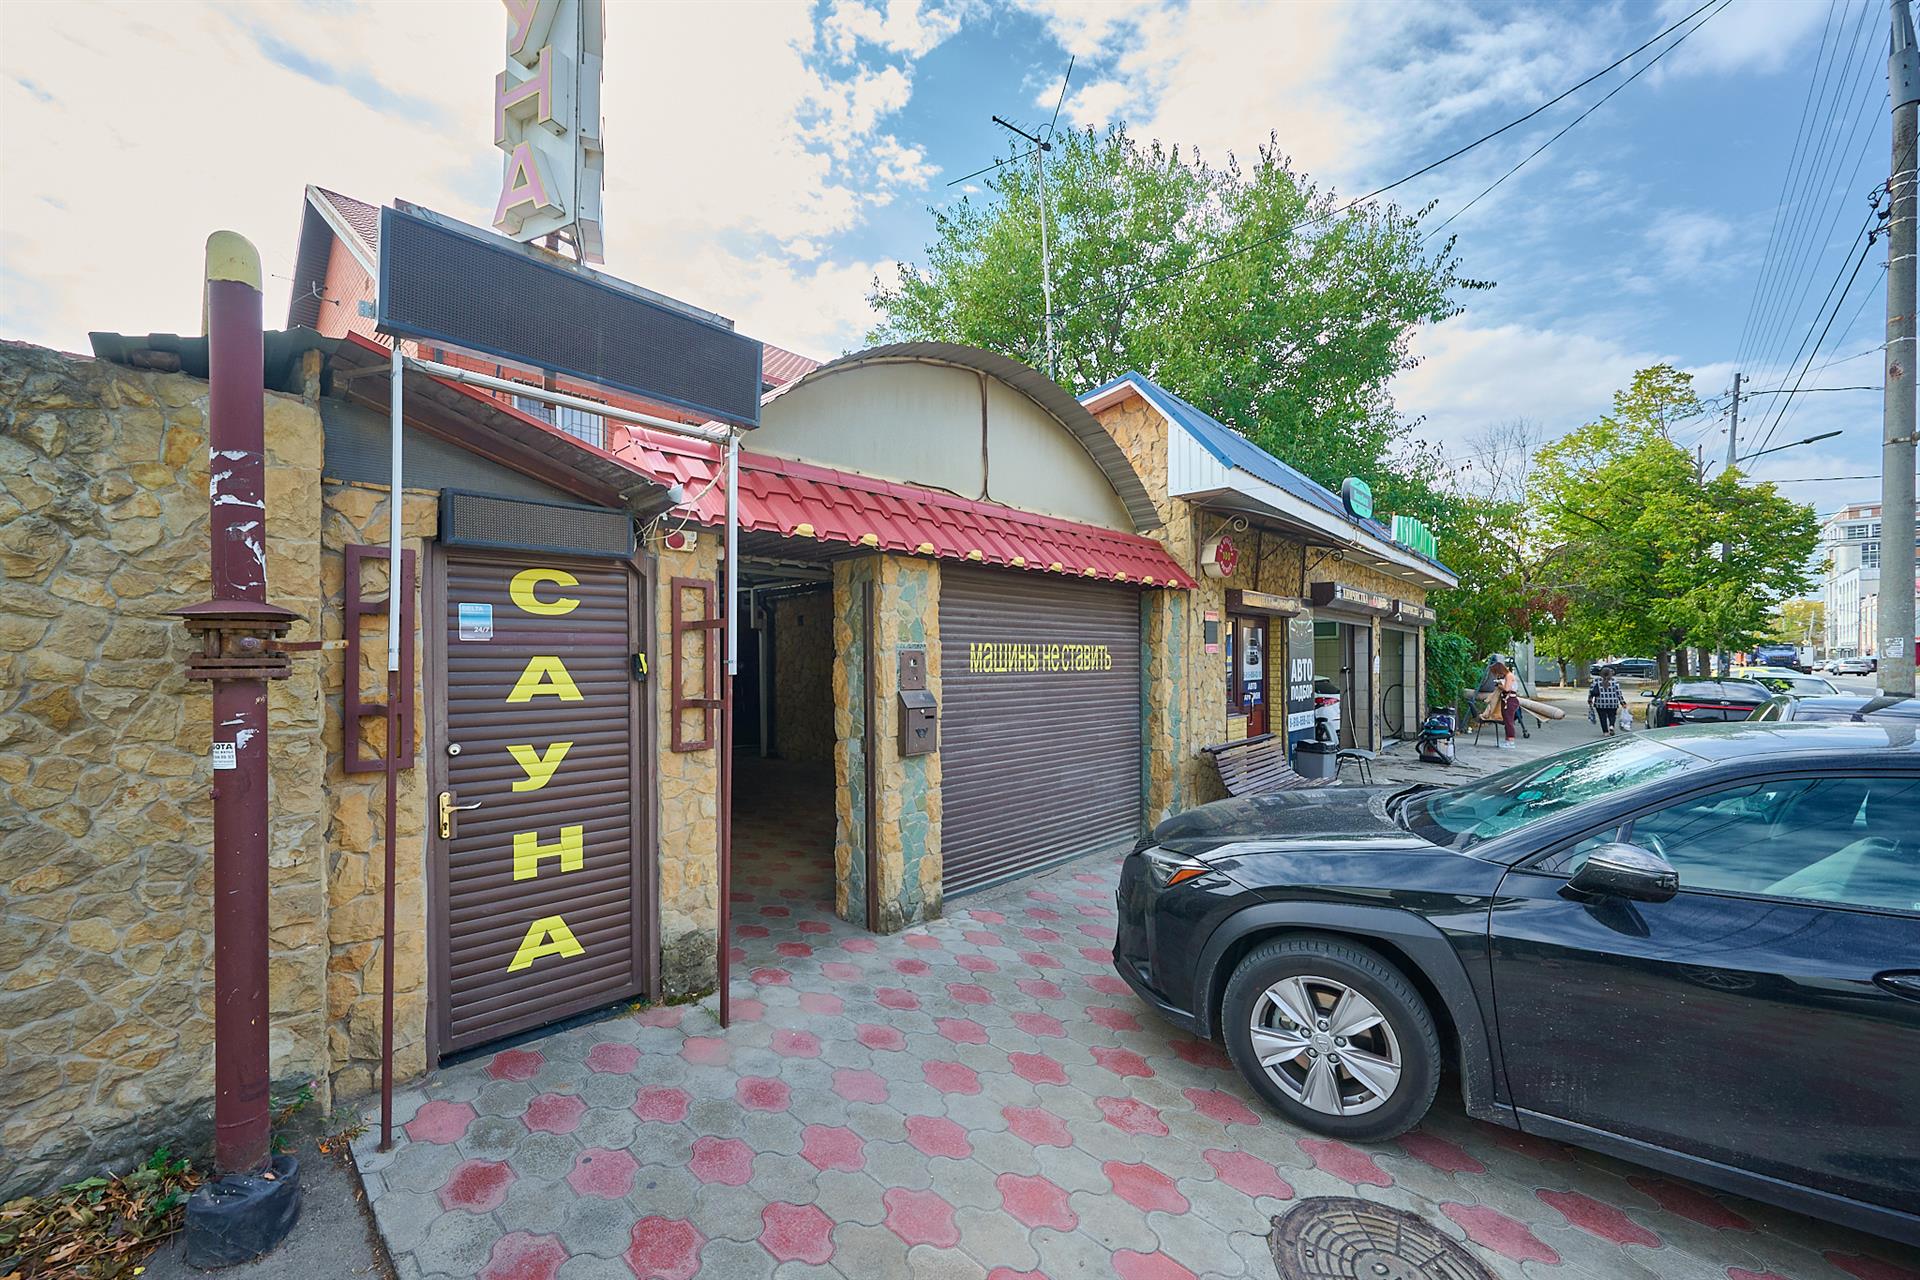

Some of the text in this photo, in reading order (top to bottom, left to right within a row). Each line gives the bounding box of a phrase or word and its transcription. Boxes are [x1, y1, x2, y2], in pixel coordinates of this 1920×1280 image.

[969, 642, 1112, 673] машины не ставить
[1290, 658, 1313, 683] АВТО
[1290, 683, 1313, 702] ПОДБОР
[505, 568, 586, 973] САУНА
